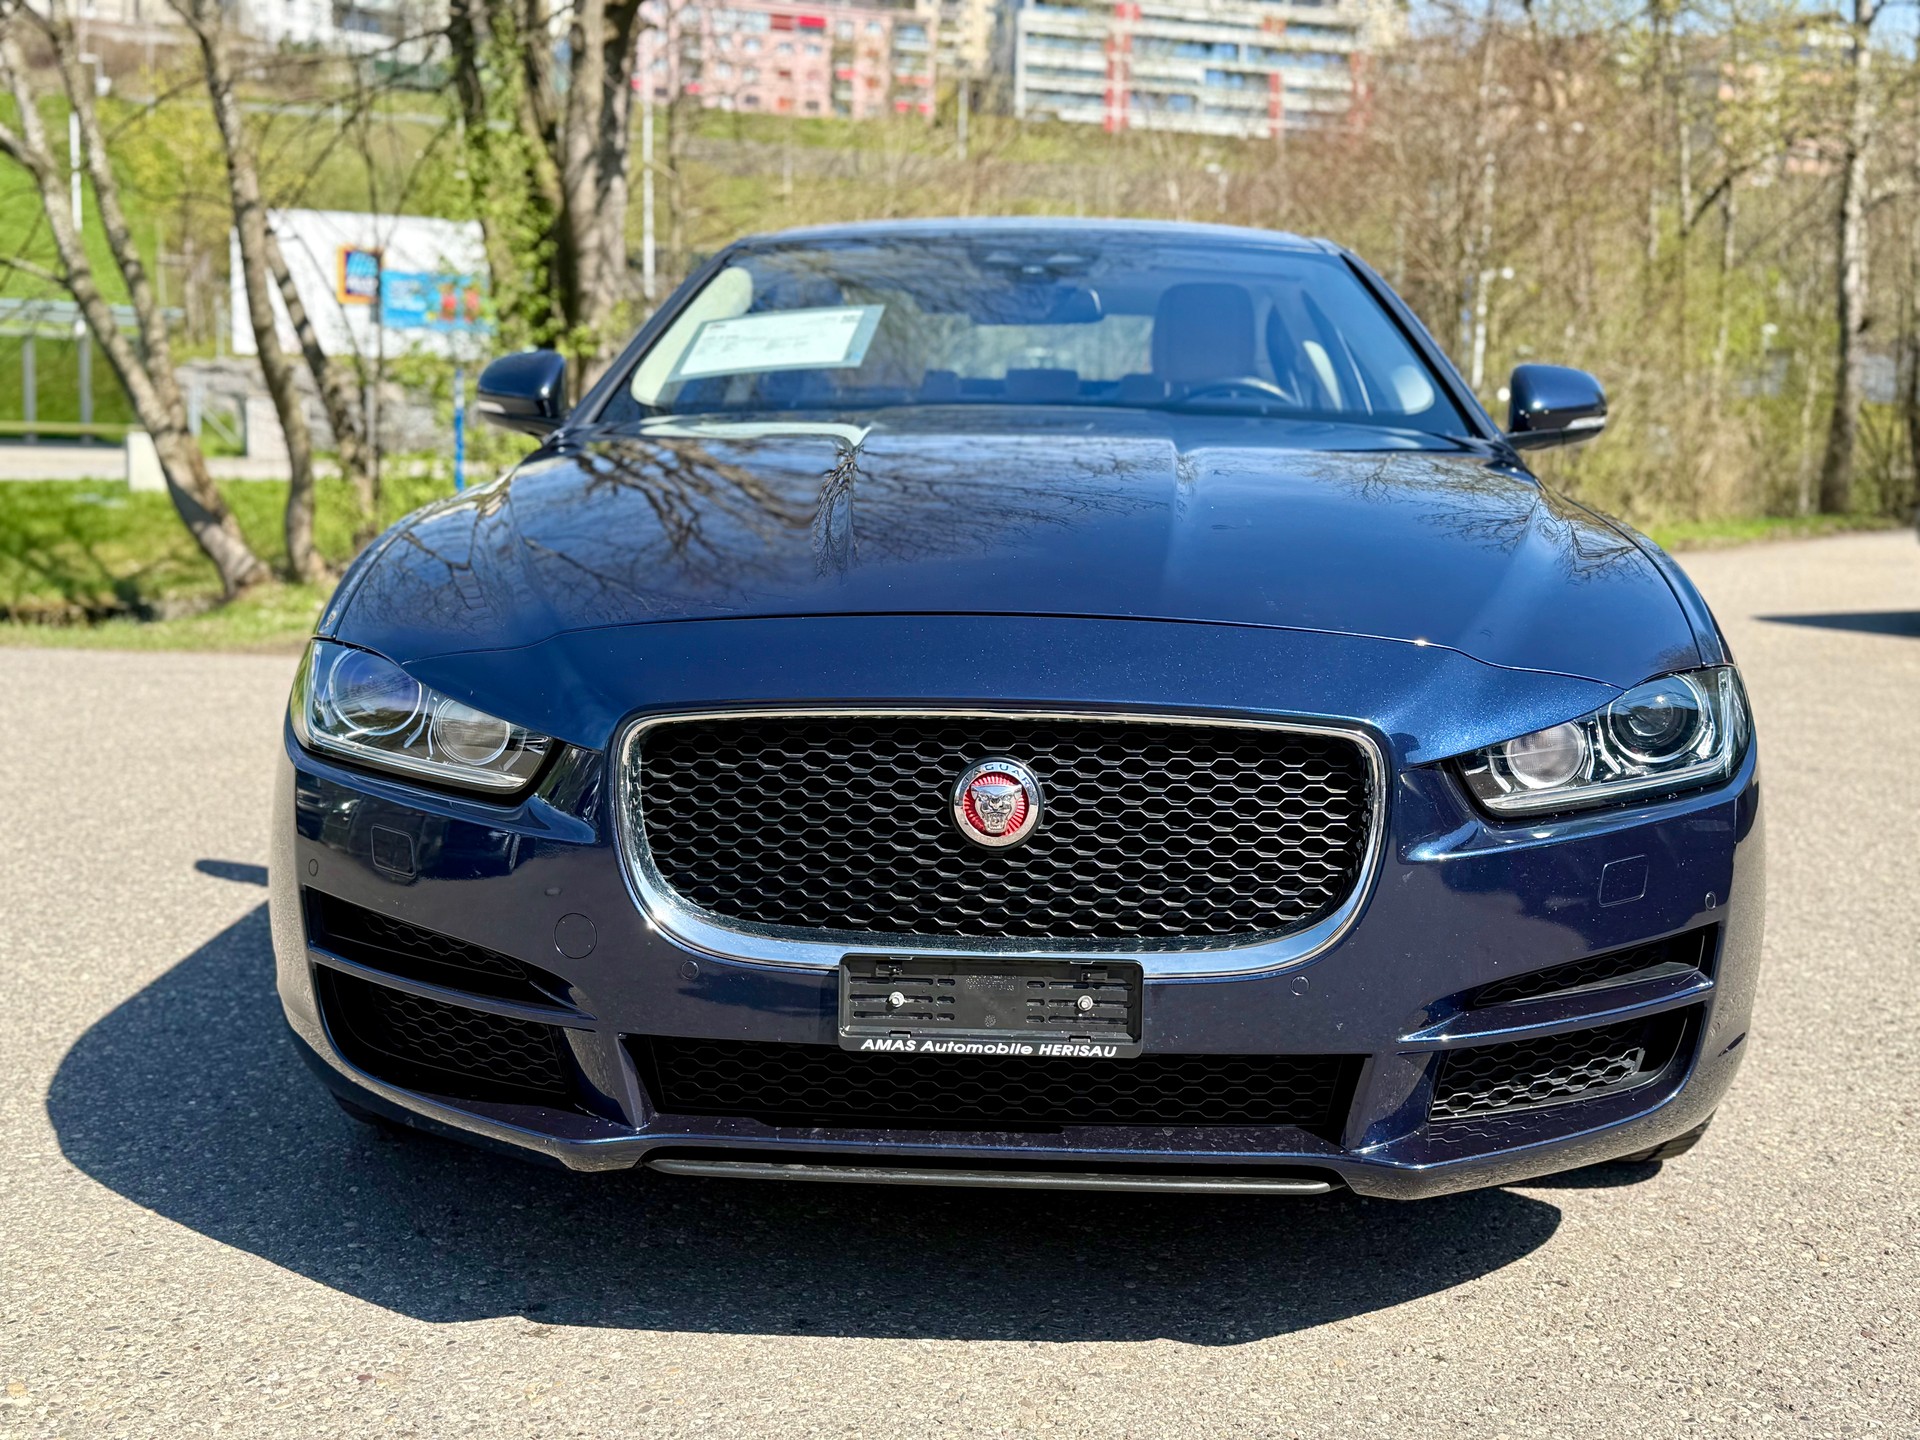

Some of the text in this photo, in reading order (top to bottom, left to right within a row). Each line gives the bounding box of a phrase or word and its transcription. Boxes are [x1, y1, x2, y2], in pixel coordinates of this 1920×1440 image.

[861, 1039, 1117, 1057] AMAS Automobile HERISAU
